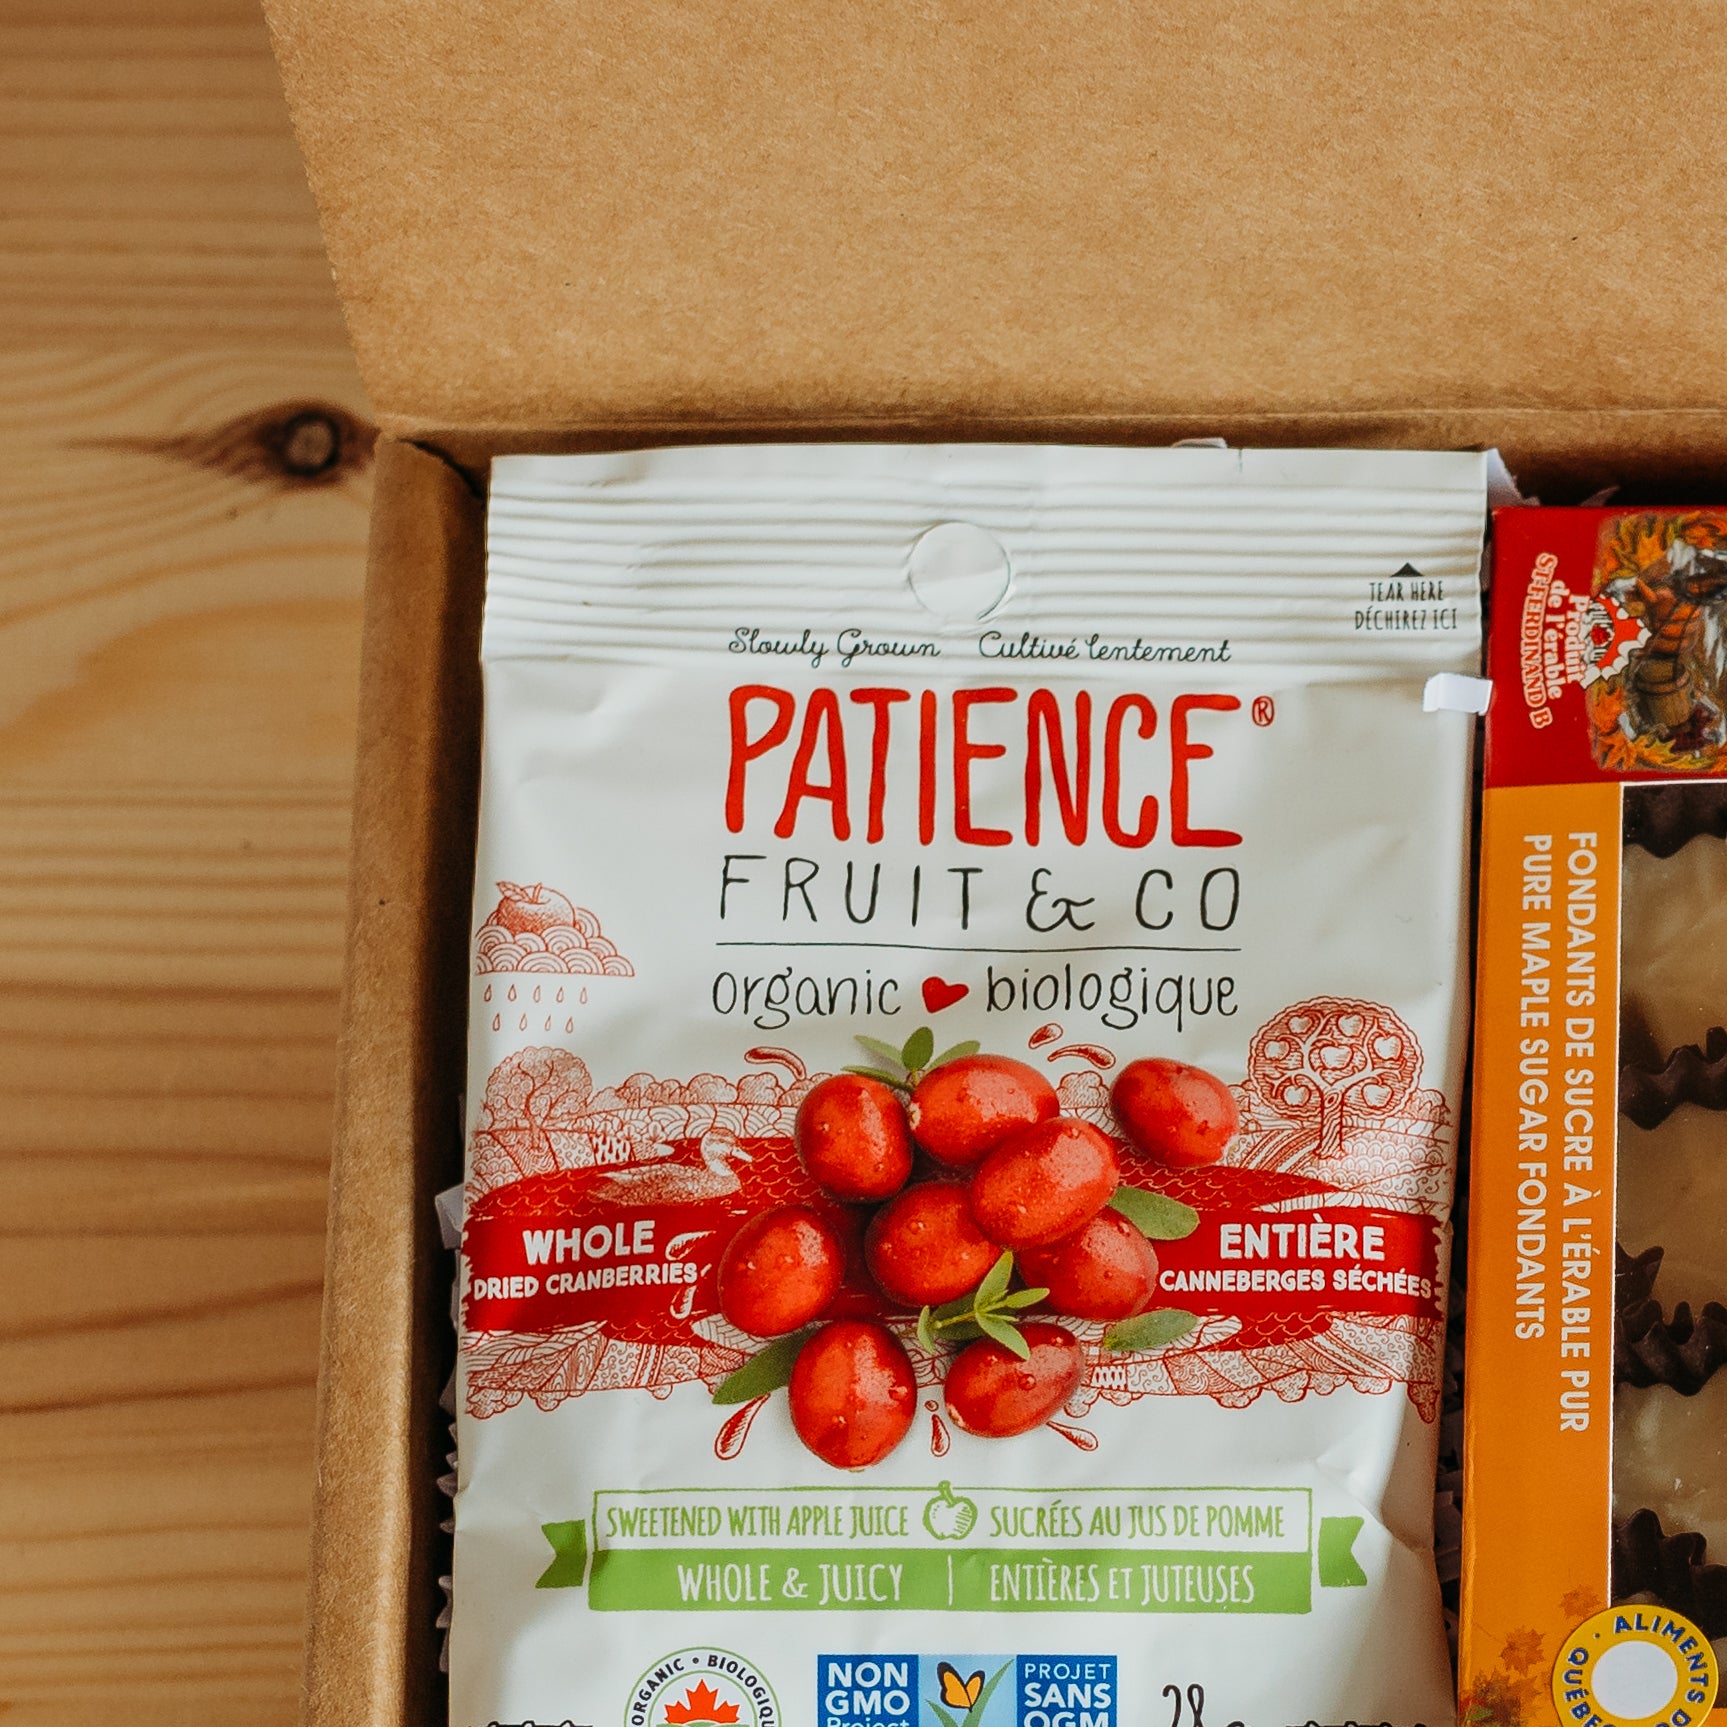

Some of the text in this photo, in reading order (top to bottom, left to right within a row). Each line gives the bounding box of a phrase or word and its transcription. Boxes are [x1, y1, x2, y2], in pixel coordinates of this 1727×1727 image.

[1369, 581, 1443, 601] TEAR HERE
[1355, 606, 1457, 630] DÉCHIREZ ICI
[1544, 580, 1570, 699] de l'érable
[1565, 595, 1590, 684] Produit
[728, 627, 1231, 670] Slowly Grown Cultivé lentement
[1529, 707, 1553, 729] B
[721, 855, 1240, 932] FRUIT & CO
[713, 966, 901, 1030] organic
[986, 963, 1239, 1032] biologique
[1515, 835, 1552, 1339] PURE MAPLE SUGAR FONDANTS
[1560, 832, 1601, 1432] FONDANTS DE SUCRE À L'ÉRABLE PUR
[522, 1219, 655, 1266] WHOLE
[1220, 1213, 1385, 1260] ENTIÈRE
[474, 1262, 698, 1300] DRIED CRANBERRIES
[1159, 1264, 1432, 1299] CANNEBERGES SÉCHÉES
[606, 1504, 909, 1539] SWEETENED WITH APPLE JUICE
[989, 1499, 1285, 1539] SUCRÉES AU JUS DE POMME
[677, 1563, 904, 1606] WHOLE & JUICY
[989, 1557, 1255, 1606] ENTIÈRES ET JUTEUSES
[828, 1661, 909, 1688] NON
[1025, 1663, 1111, 1680] PROJET
[1614, 1613, 1709, 1704] ALIMENTS
[631, 1658, 685, 1726] ORGANIC
[825, 1690, 910, 1715] GMO
[1024, 1683, 1112, 1709] SANS
